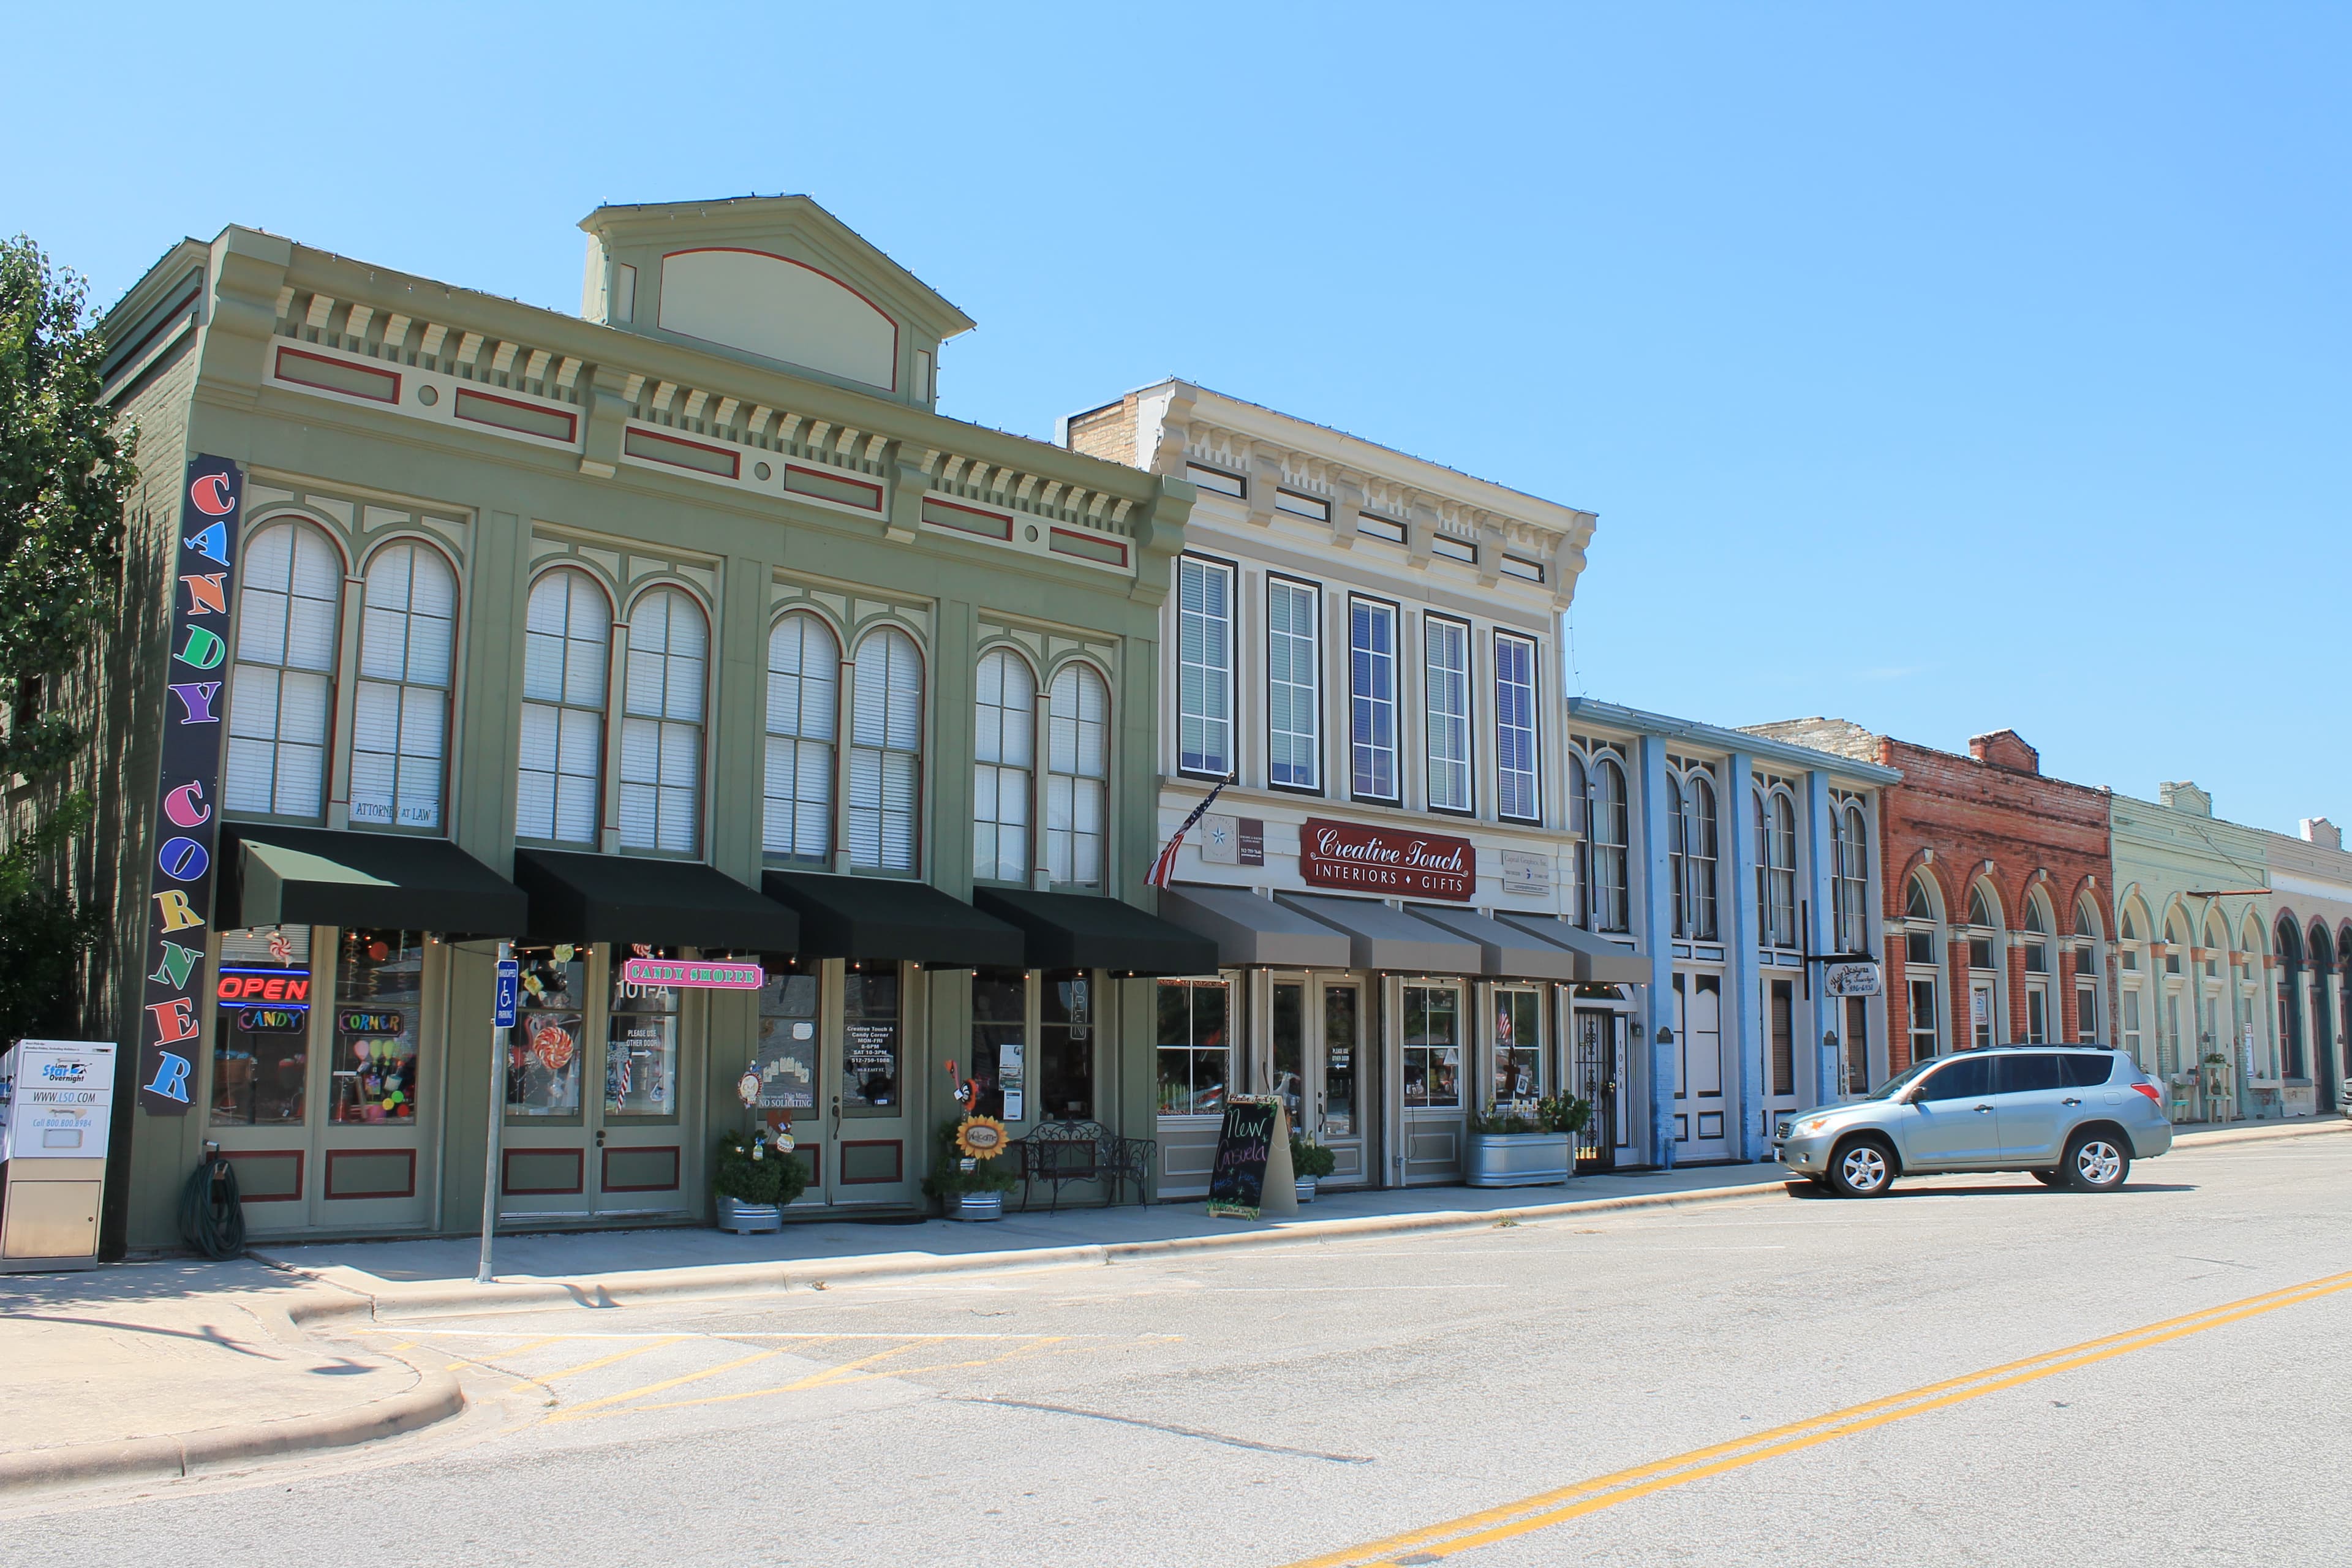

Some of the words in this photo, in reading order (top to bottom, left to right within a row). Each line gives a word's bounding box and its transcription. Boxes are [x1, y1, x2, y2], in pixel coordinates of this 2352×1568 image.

[167, 472, 236, 725] CANDY
[402, 808, 411, 818] AT
[412, 808, 432, 821] LAW
[1317, 828, 1400, 864] Creative
[1405, 840, 1463, 870] Touch
[1316, 864, 1396, 884] INTERIORS
[1422, 876, 1462, 891] GIFTS
[143, 779, 211, 1104] CORNER
[631, 965, 685, 981] CANDY
[690, 967, 755, 984] SHOPPE
[217, 977, 309, 1000] OPEN
[616, 979, 670, 999] 101-A
[1074, 981, 1086, 1035] OPEN
[239, 1011, 300, 1029] CANDY
[341, 1014, 399, 1031] CORNER
[42, 1064, 69, 1076] Star
[49, 1074, 85, 1084] Overnight
[33, 1092, 96, 1103] WWW.LSO.COM
[33, 1118, 45, 1127] Call
[1227, 1108, 1267, 1139] New
[968, 1131, 997, 1142] Welcome
